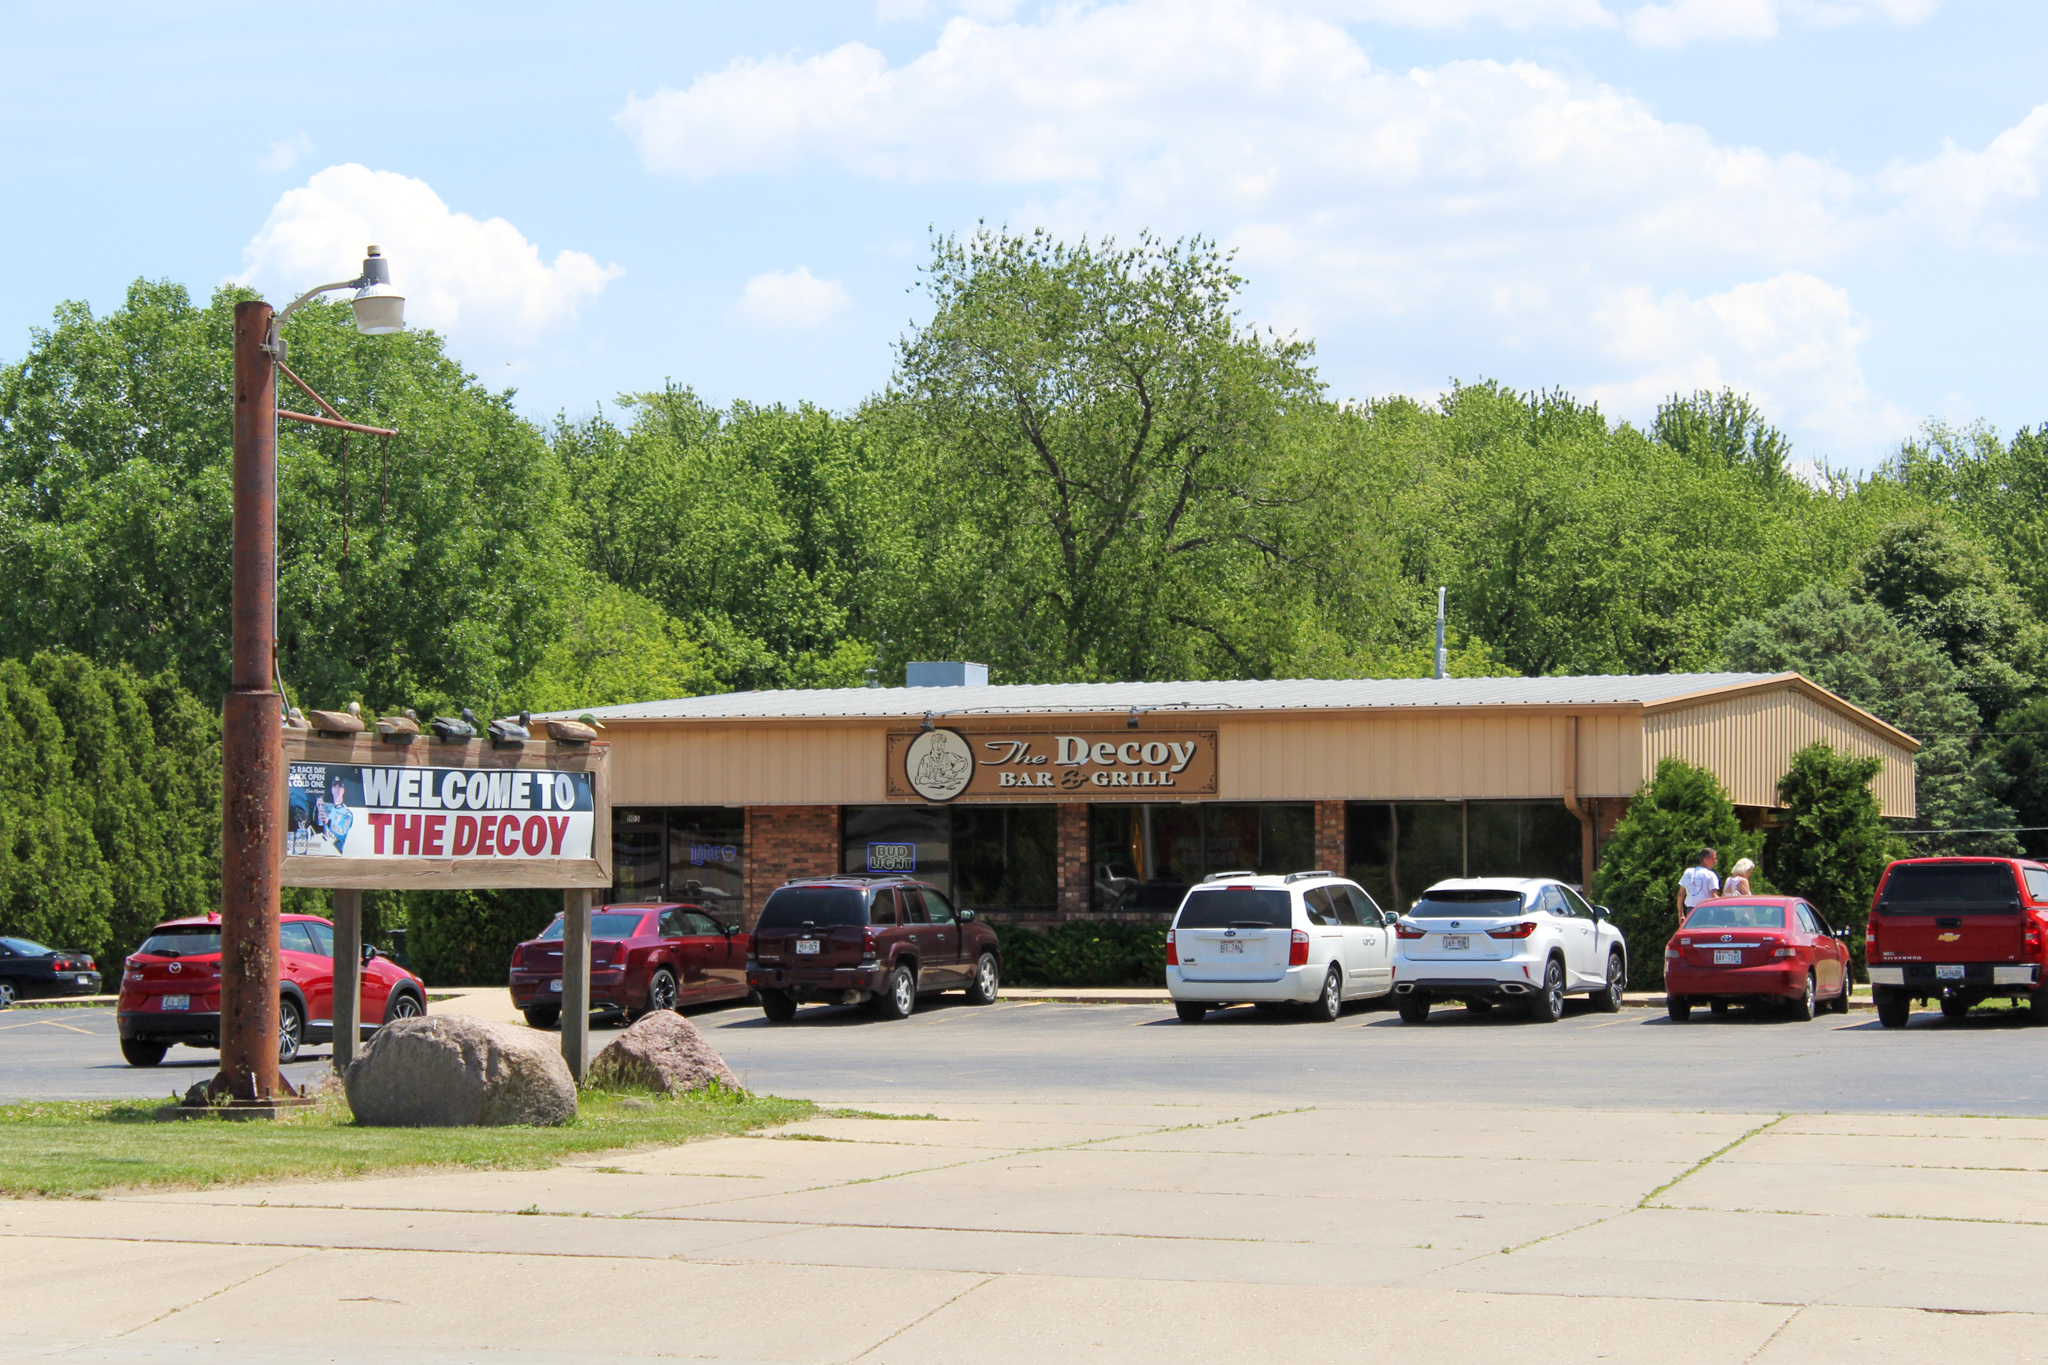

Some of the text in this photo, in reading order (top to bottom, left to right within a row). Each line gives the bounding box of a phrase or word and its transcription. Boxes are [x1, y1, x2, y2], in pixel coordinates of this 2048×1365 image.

[979, 736, 1195, 773] The Decoy
[297, 766, 313, 774] RACE
[293, 780, 310, 788] COLD
[999, 769, 1175, 789] BAR & GRILL
[361, 768, 576, 810] WELCOME TO
[368, 813, 571, 856] THE DECOY
[876, 845, 907, 858] BUD
[870, 857, 913, 869] LIGHT
